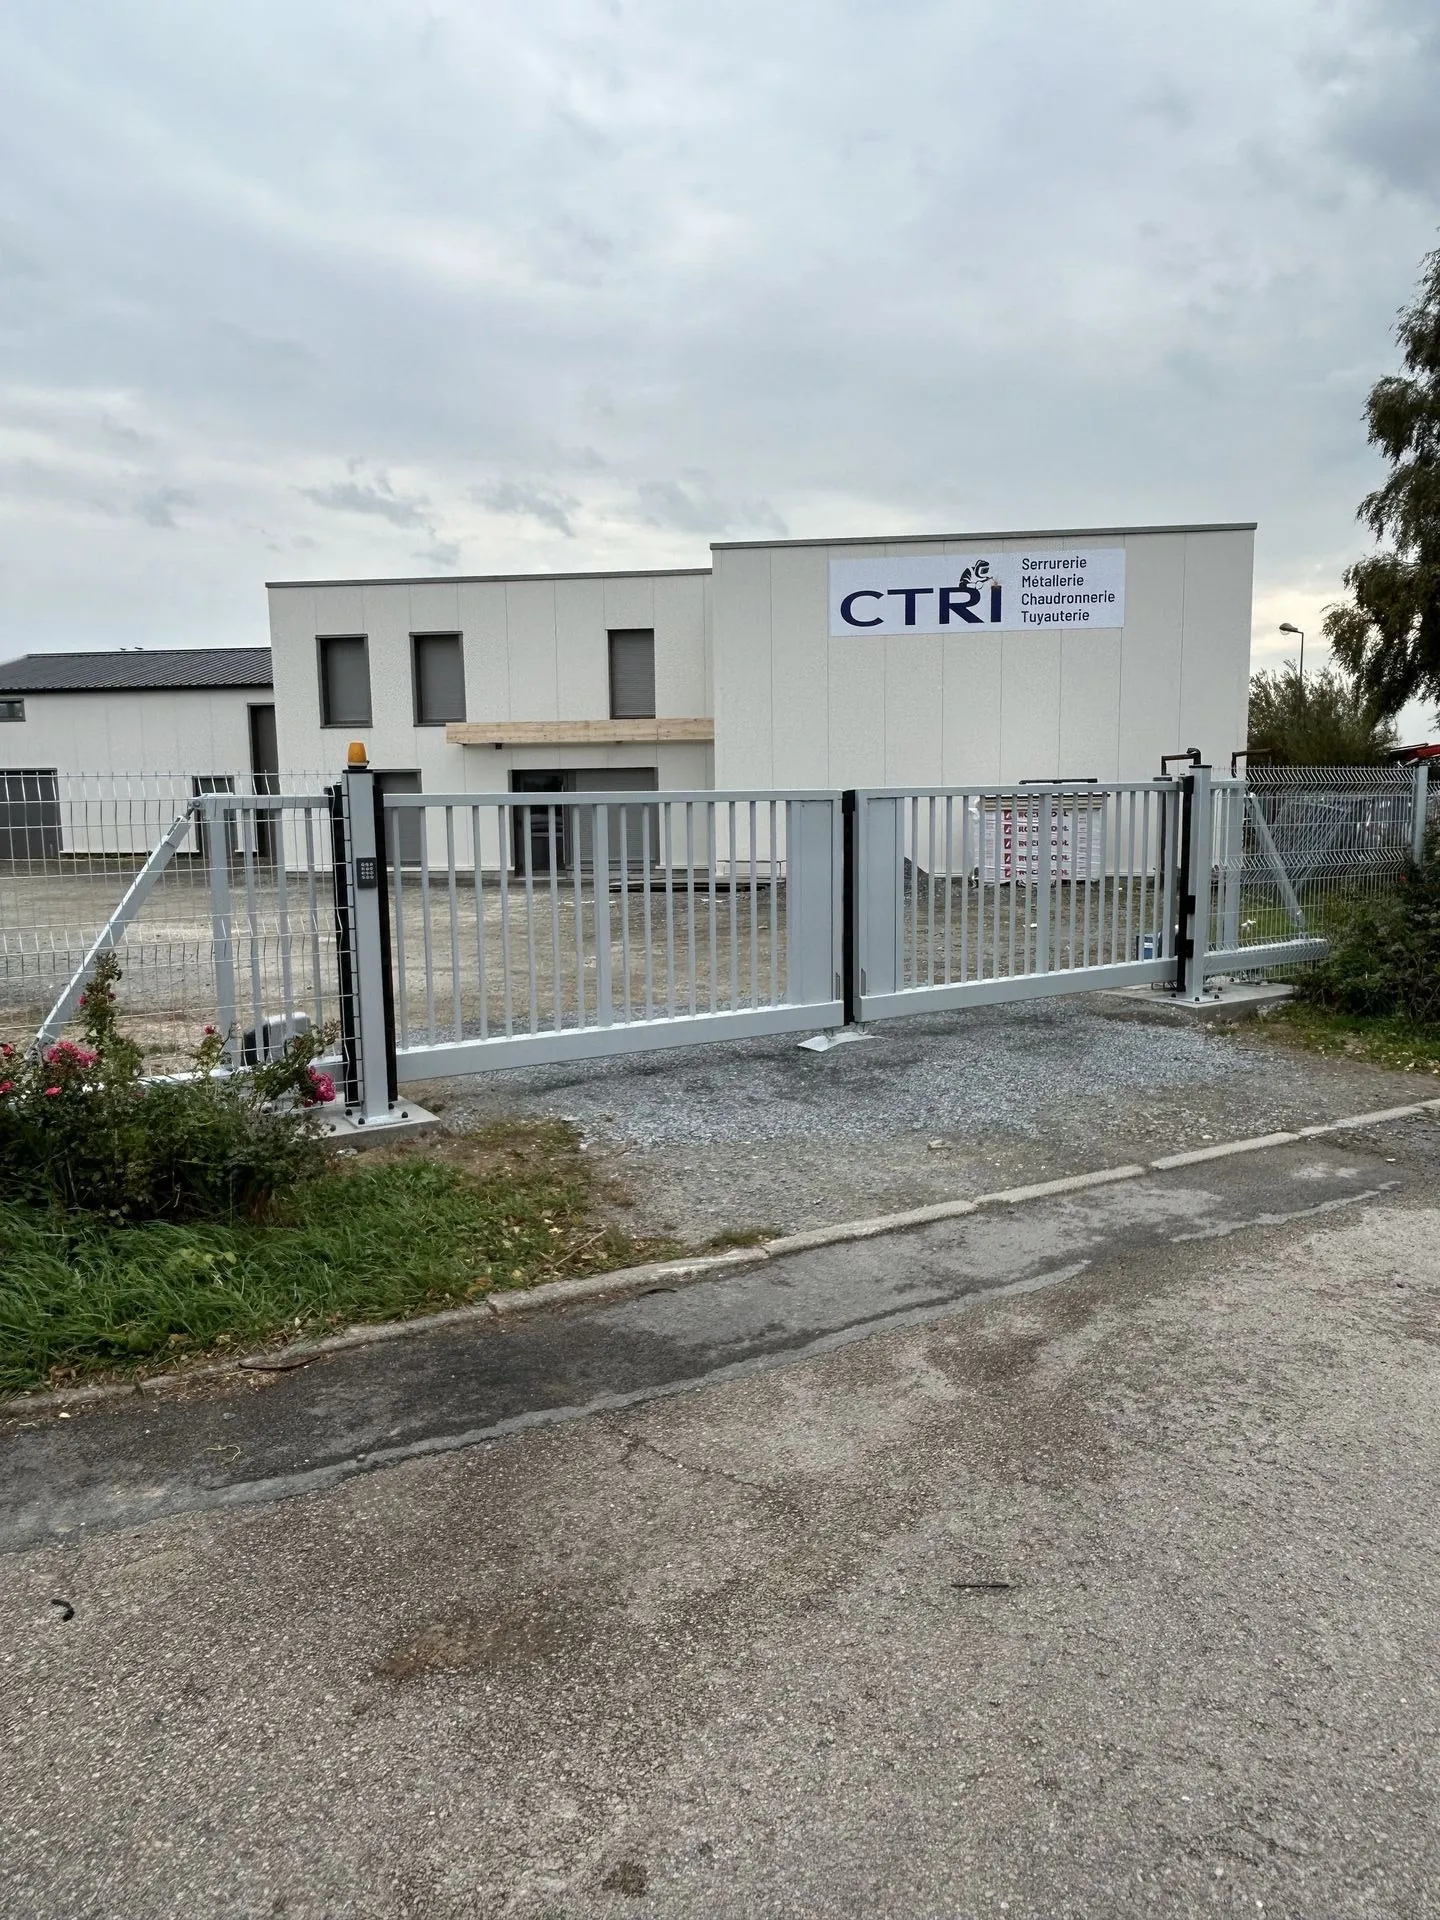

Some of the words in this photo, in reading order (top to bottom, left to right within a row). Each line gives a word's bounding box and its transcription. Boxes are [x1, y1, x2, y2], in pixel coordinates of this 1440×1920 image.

[1021, 555, 1087, 571] Serrurerie
[1021, 573, 1084, 588] Métallerie
[1021, 590, 1115, 606] Chaudronnerie
[840, 585, 1002, 628] CTRI
[1021, 608, 1090, 626] Tuyauterie
